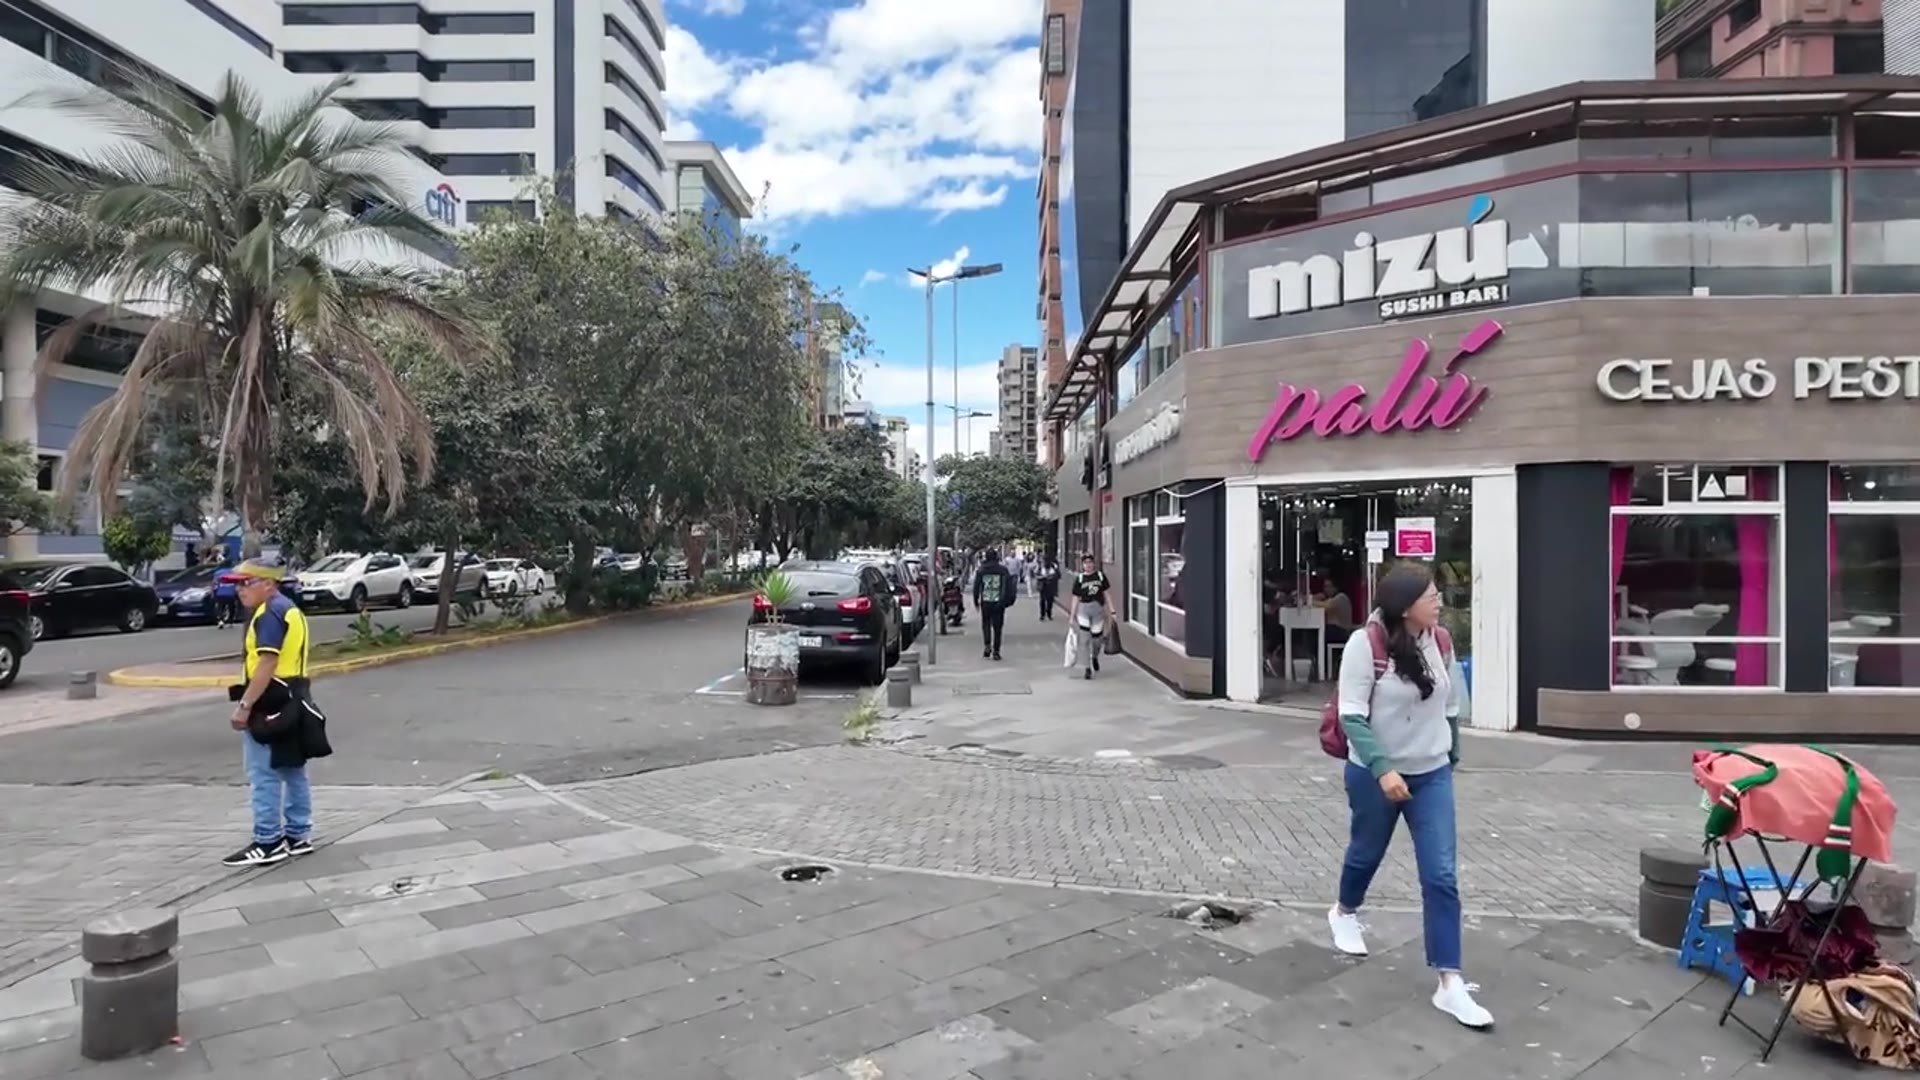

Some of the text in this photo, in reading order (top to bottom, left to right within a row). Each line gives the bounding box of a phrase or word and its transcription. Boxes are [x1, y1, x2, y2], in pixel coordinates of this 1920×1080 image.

[426, 184, 458, 227] citi
[1248, 195, 1508, 319] mizú
[1380, 294, 1444, 316] SUSHI
[1247, 321, 1504, 462] palú
[1597, 355, 1920, 402] CEJAS PEST
